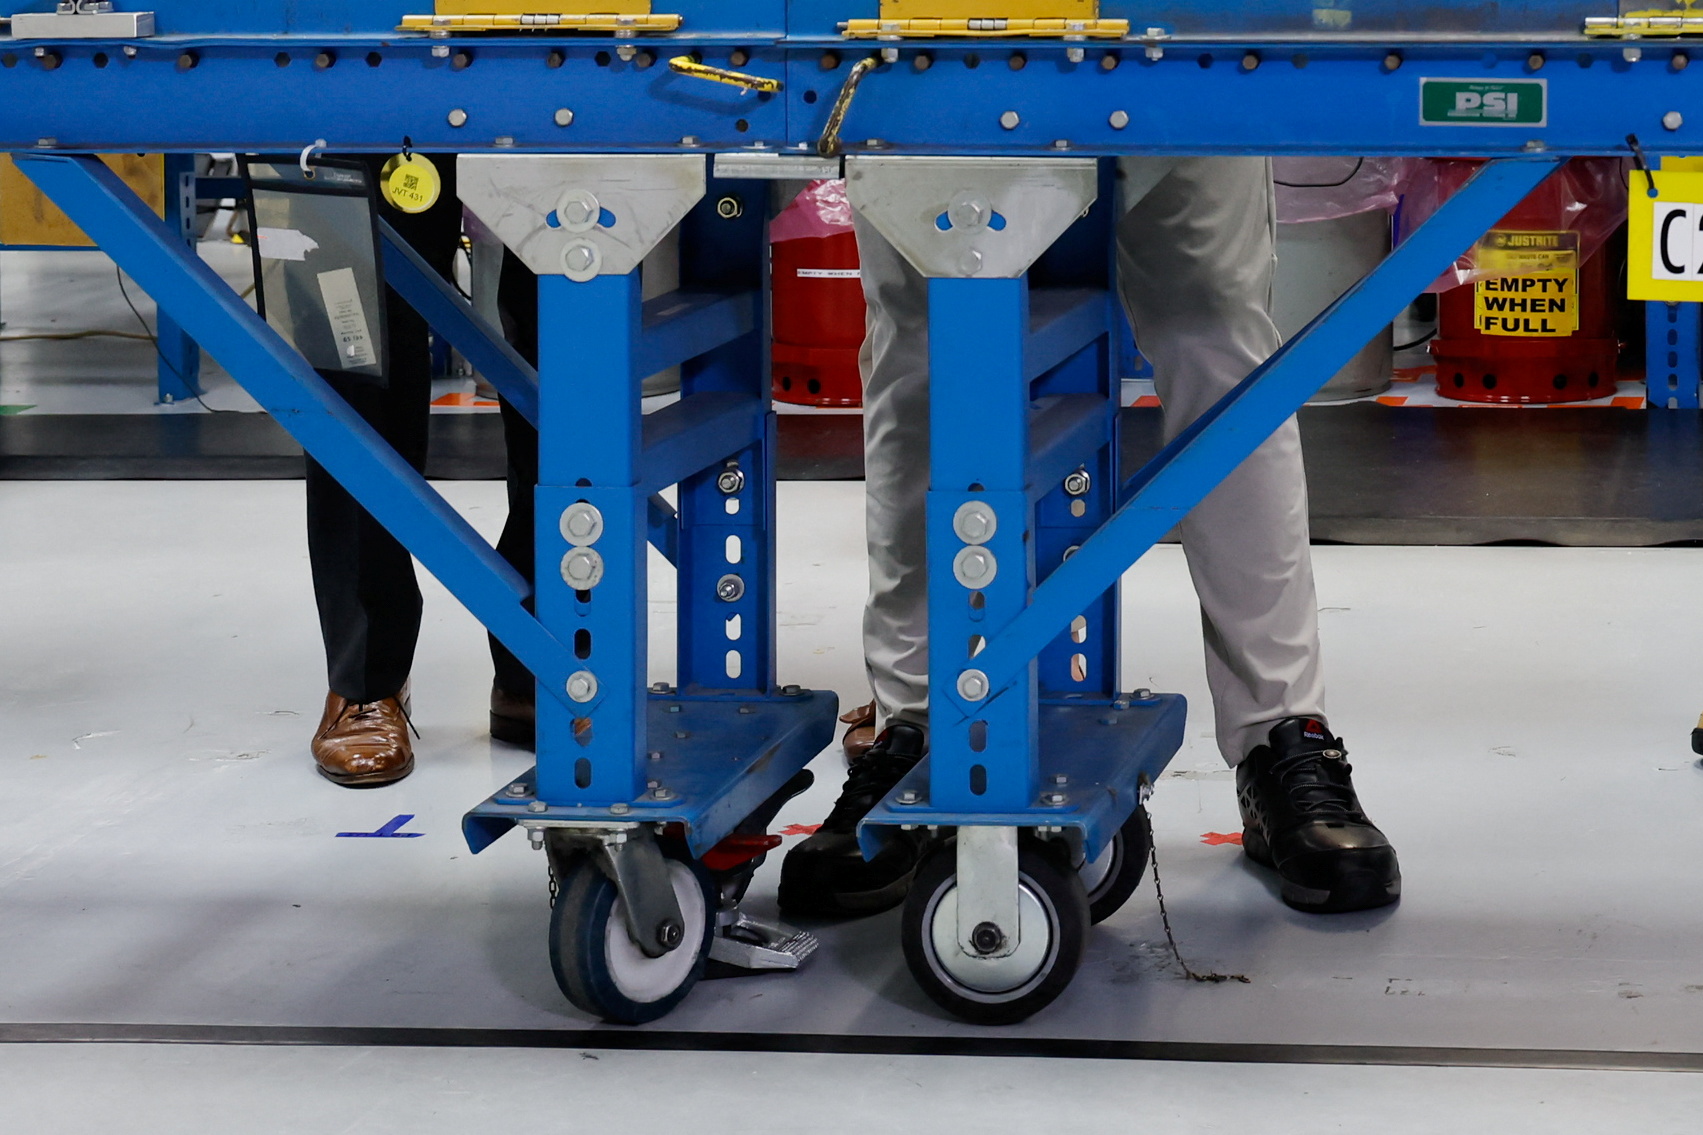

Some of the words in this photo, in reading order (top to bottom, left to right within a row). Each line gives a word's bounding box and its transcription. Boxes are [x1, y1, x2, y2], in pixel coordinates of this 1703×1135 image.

[1455, 91, 1519, 117] PSI
[392, 187, 408, 197] JVT
[409, 192, 423, 202] 431
[1508, 235, 1559, 248] JUSTRITE
[1485, 277, 1569, 293] EMPTY
[1484, 296, 1566, 313] WHEN
[1485, 316, 1557, 333] FULL
